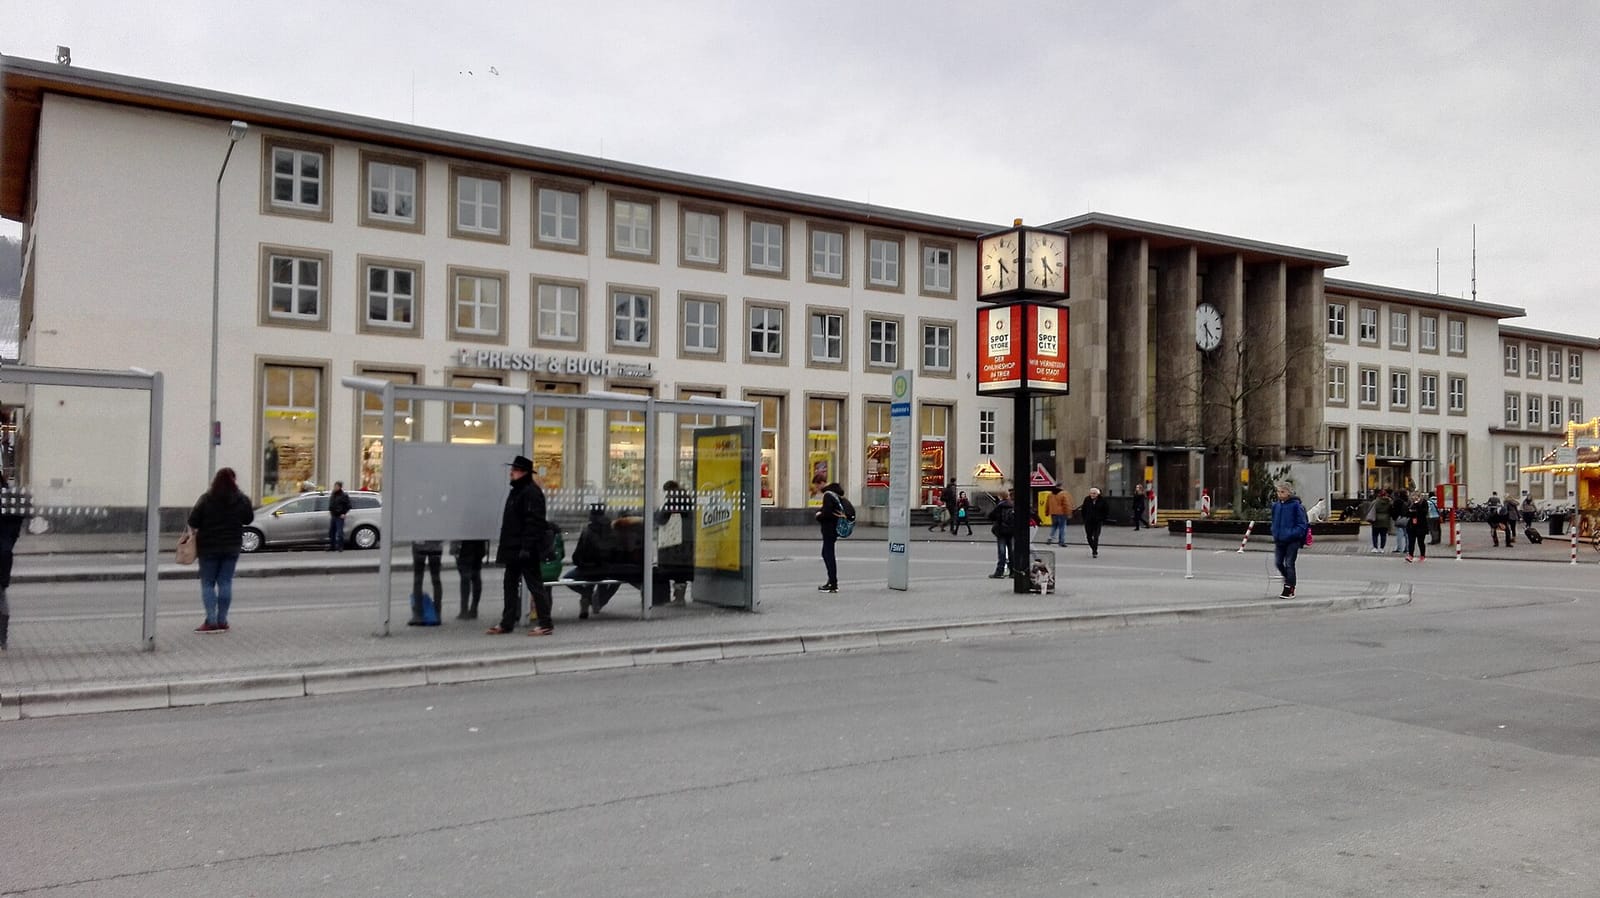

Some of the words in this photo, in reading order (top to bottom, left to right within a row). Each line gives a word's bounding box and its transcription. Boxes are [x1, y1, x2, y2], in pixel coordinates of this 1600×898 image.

[990, 335, 1009, 343] SPOT
[1038, 334, 1056, 342] SPOT
[990, 342, 1009, 350] STORE
[1038, 341, 1056, 350] CITY
[477, 350, 543, 372] PRESSE
[547, 355, 562, 374] &
[566, 356, 611, 376] BUCH
[983, 362, 1016, 371] ONLINESHOP
